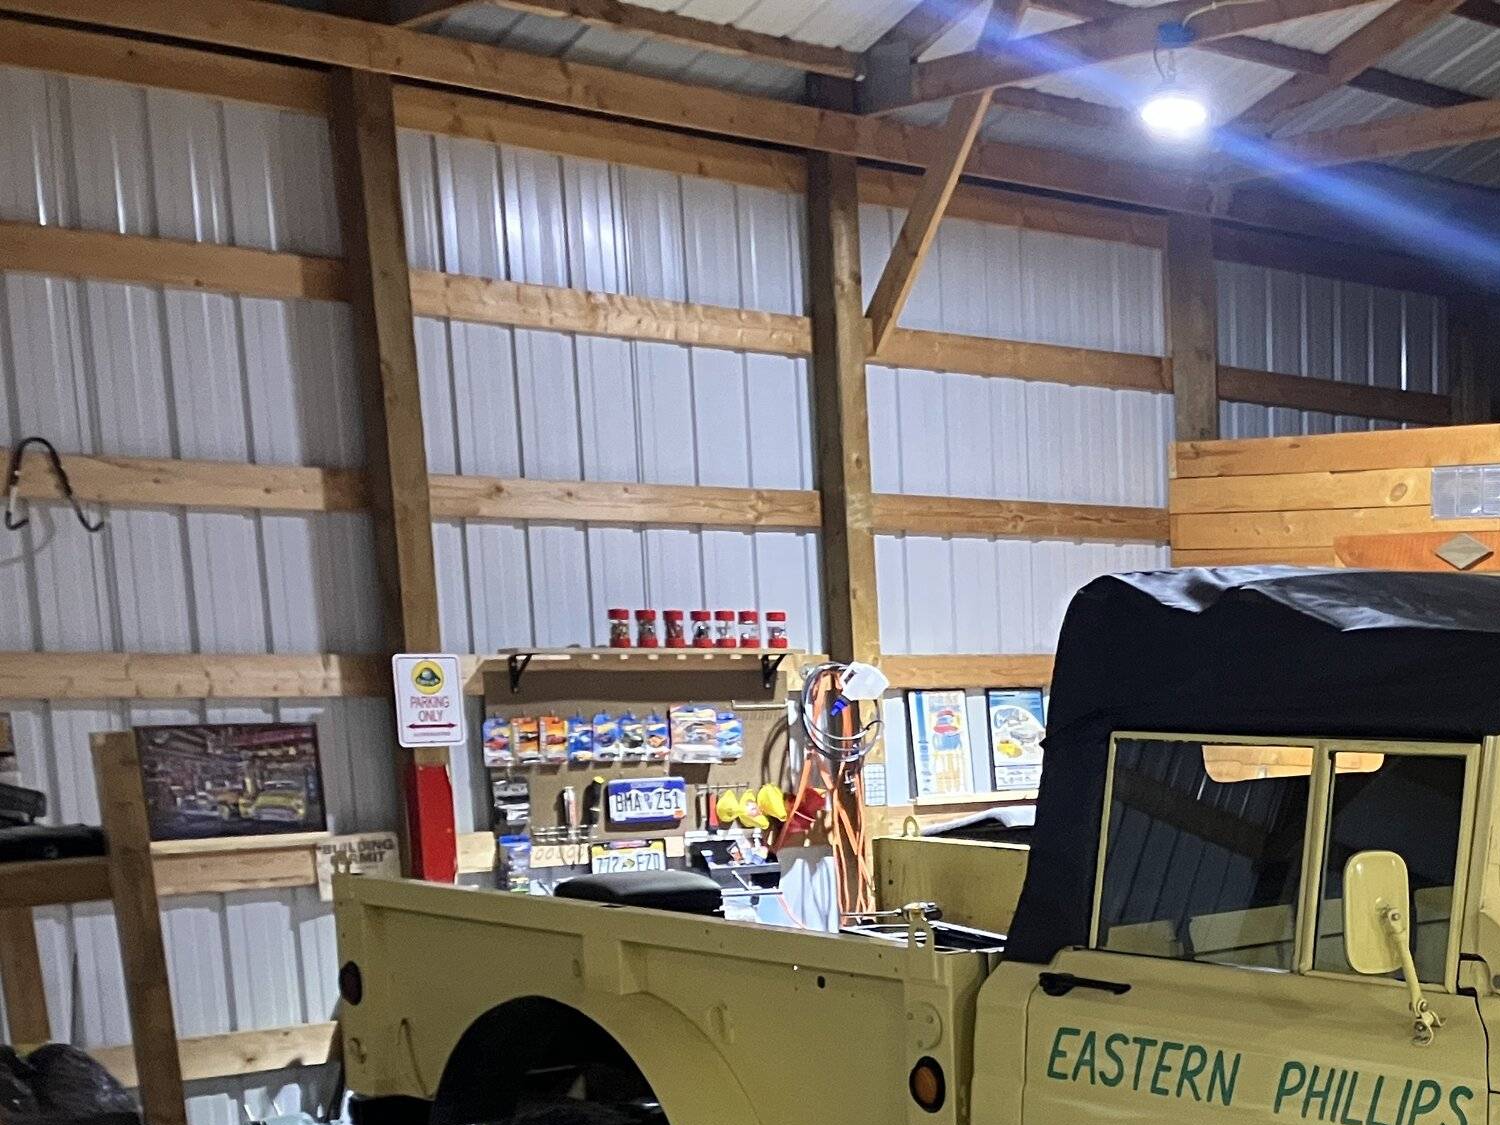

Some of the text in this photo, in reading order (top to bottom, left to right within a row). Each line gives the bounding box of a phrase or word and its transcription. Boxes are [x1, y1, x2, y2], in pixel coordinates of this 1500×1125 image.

[410, 695, 450, 709] PARKING
[418, 710, 443, 722] ONLY
[1046, 1026, 1241, 1107] EASTERN
